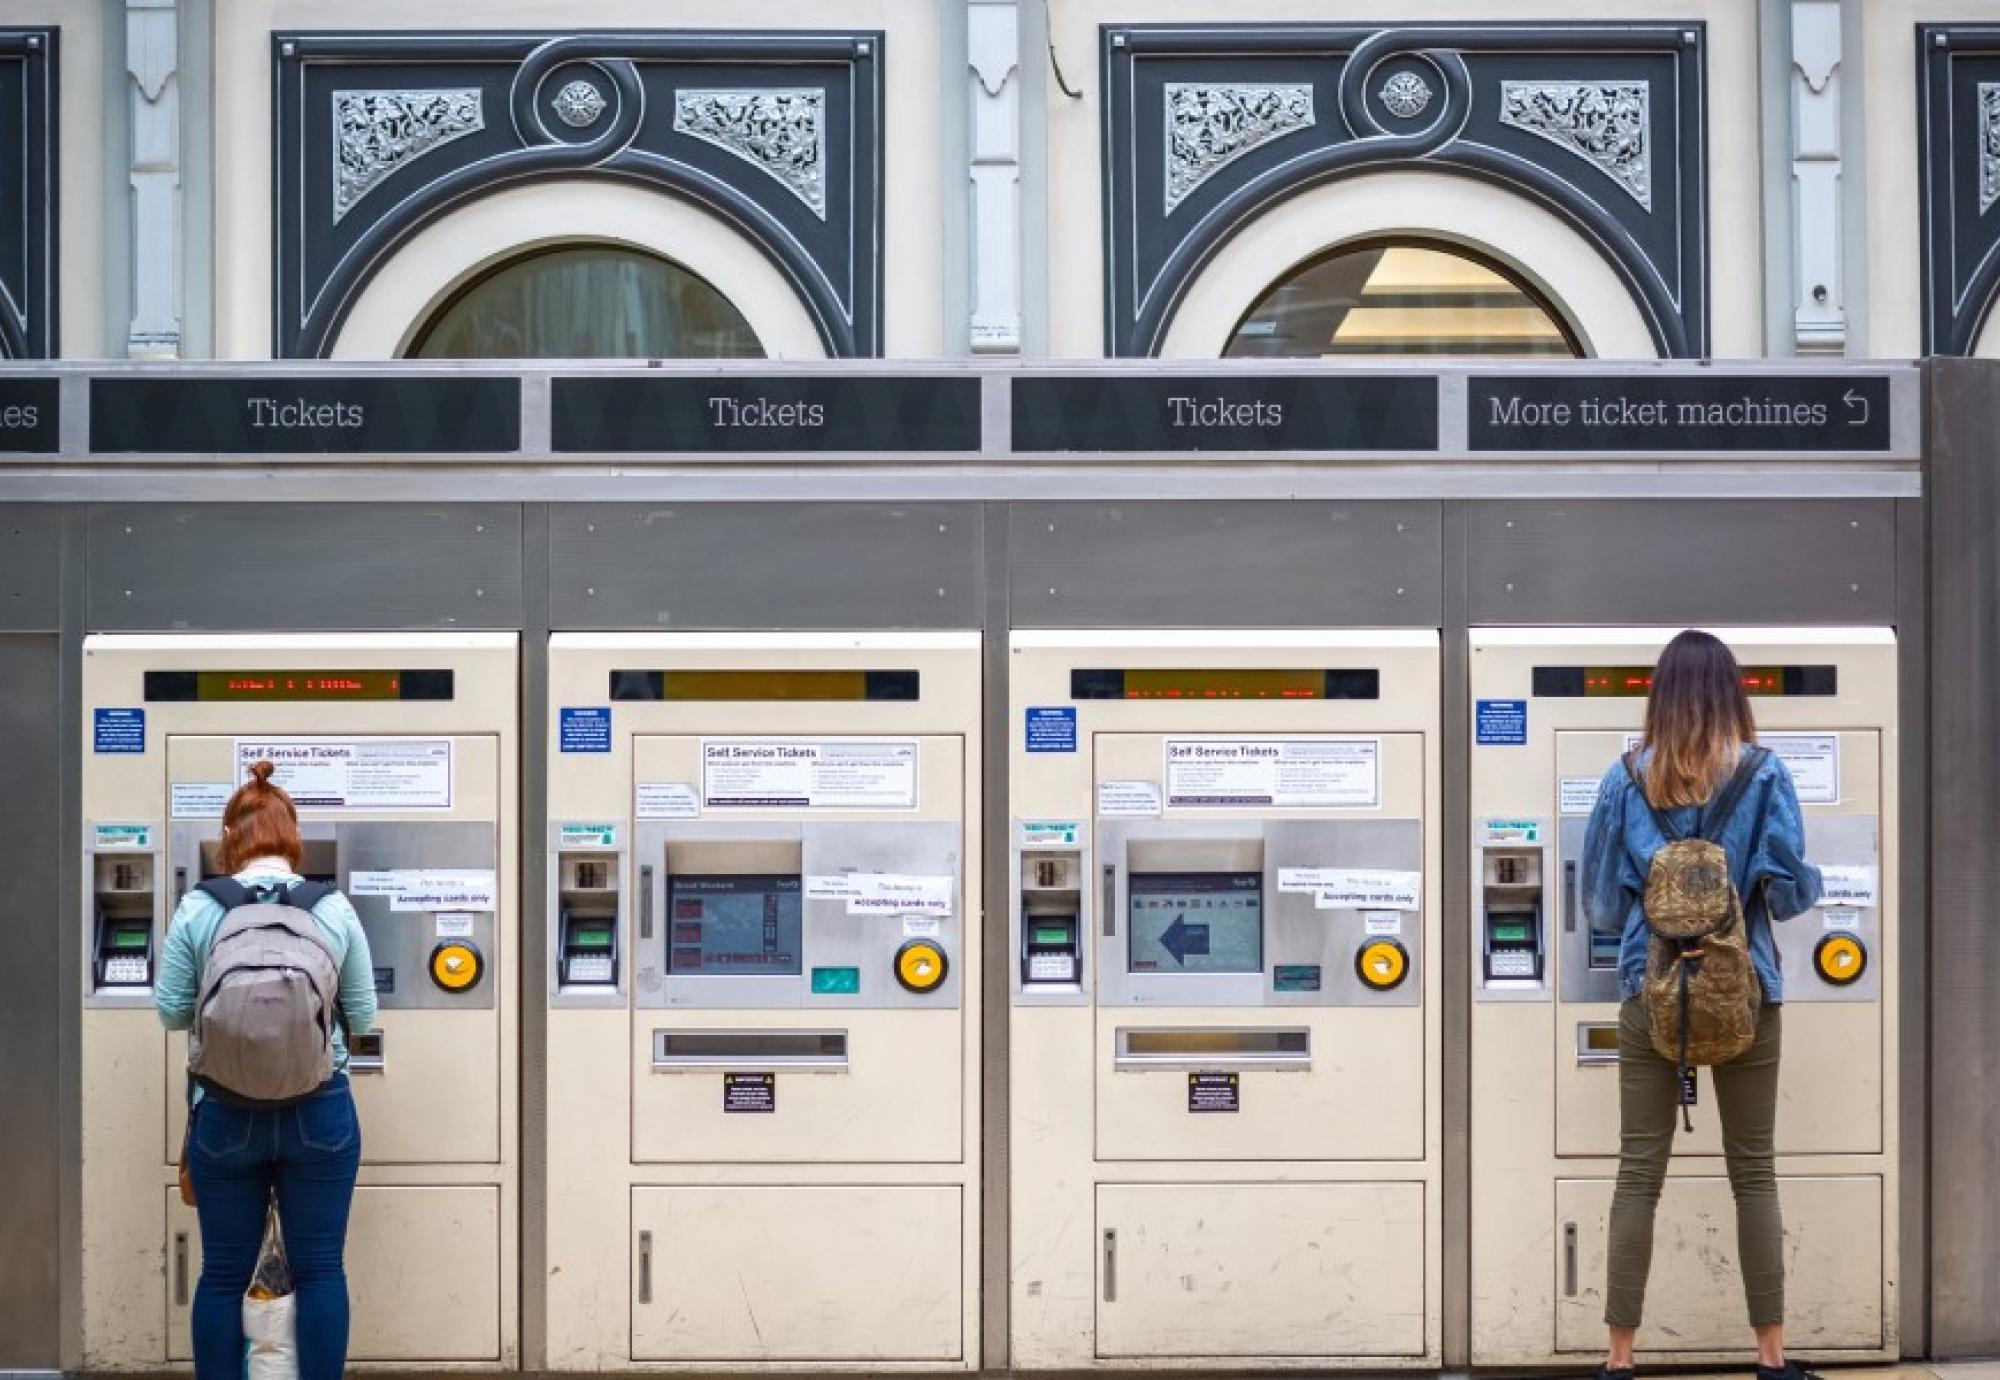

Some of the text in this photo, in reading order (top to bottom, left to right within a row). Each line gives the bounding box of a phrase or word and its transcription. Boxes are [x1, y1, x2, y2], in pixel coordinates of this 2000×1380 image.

[0, 405, 38, 428] es
[247, 397, 364, 428] Tickets
[709, 397, 825, 428] Tickets
[1167, 397, 1283, 428] Tickets
[1489, 395, 1828, 426] More ticket machines
[266, 747, 309, 758] Service
[310, 747, 351, 758] Tickets
[707, 747, 817, 758] Self Service Tickets
[1169, 745, 1280, 757] Self Service Tickets
